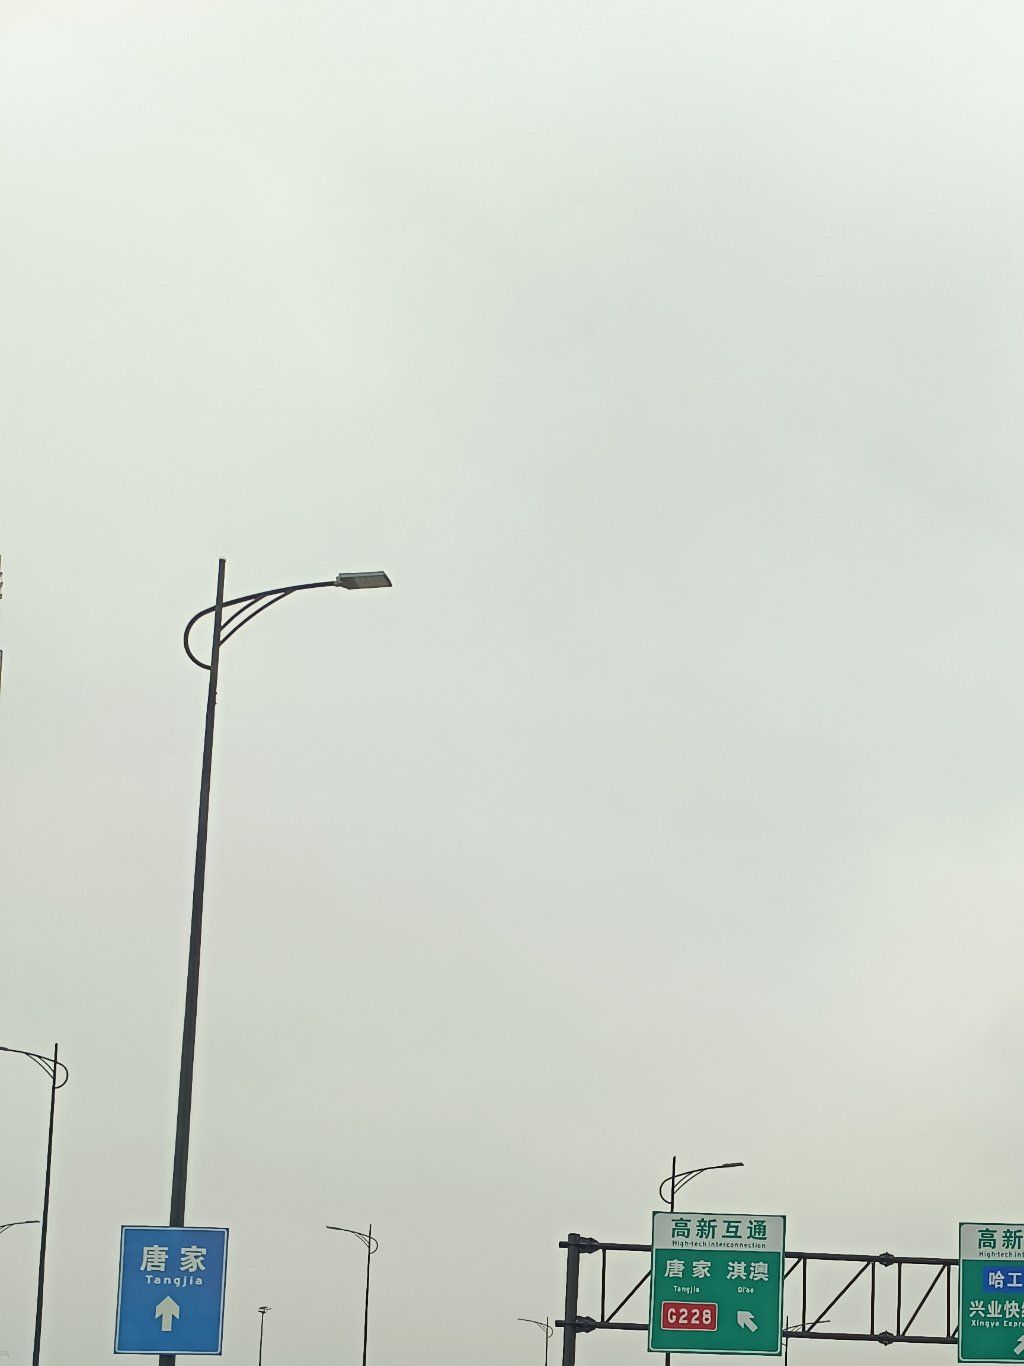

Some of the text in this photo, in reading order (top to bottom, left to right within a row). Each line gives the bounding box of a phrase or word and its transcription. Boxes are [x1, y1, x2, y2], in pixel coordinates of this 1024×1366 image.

[671, 1218, 768, 1241] 高新互通
[140, 1244, 207, 1273] 唐家
[664, 1259, 769, 1282] 唐家 淇澳
[145, 1275, 203, 1288] Tangjia
[673, 1285, 700, 1295] Tangjia
[667, 1307, 712, 1325] G228
[971, 1320, 1000, 1328] Xingye
